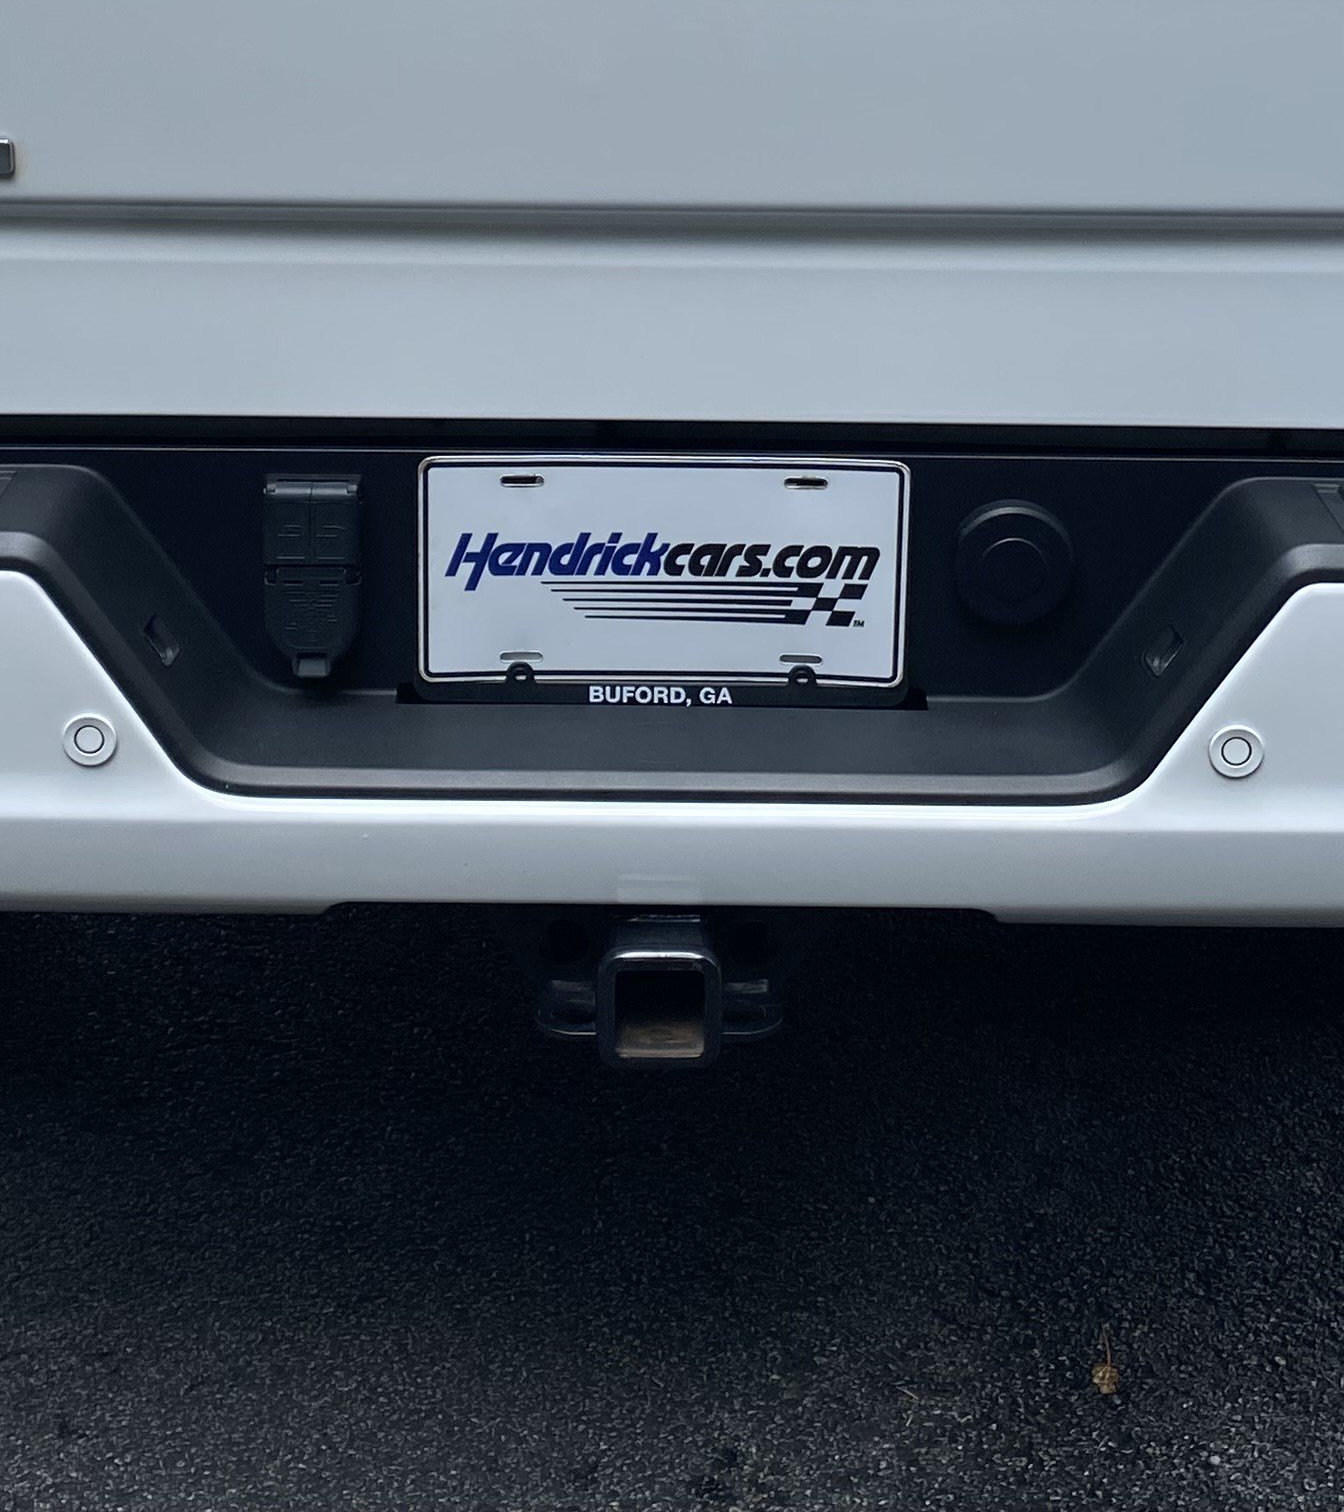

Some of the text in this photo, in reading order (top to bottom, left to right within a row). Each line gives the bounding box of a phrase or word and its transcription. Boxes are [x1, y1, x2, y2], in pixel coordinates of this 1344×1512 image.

[445, 532, 881, 591] Hendrickcars.com
[589, 686, 733, 707] BUFORD, GA
